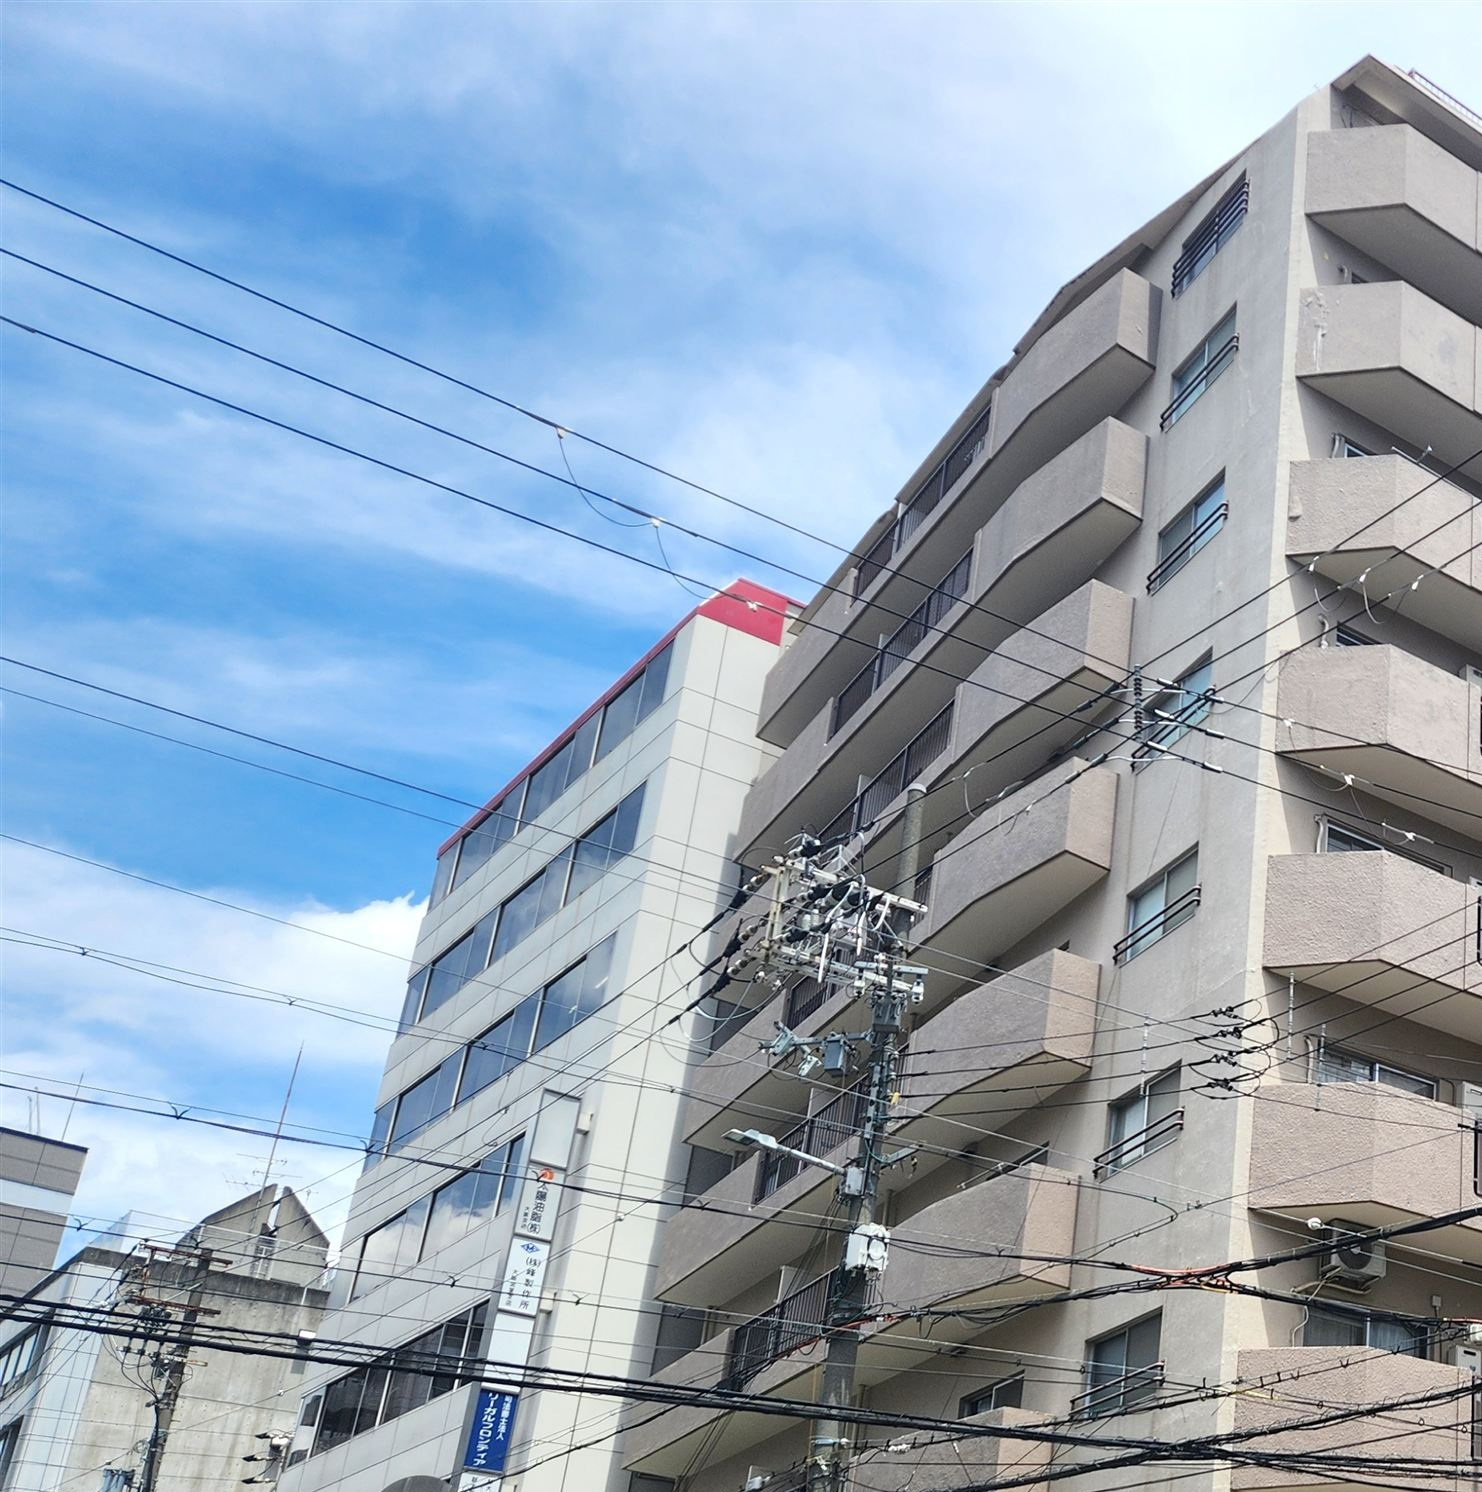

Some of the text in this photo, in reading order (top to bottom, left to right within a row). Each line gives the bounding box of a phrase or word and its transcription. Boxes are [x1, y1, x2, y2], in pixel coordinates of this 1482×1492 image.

[473, 1392, 499, 1466] リーガルフロンティア
